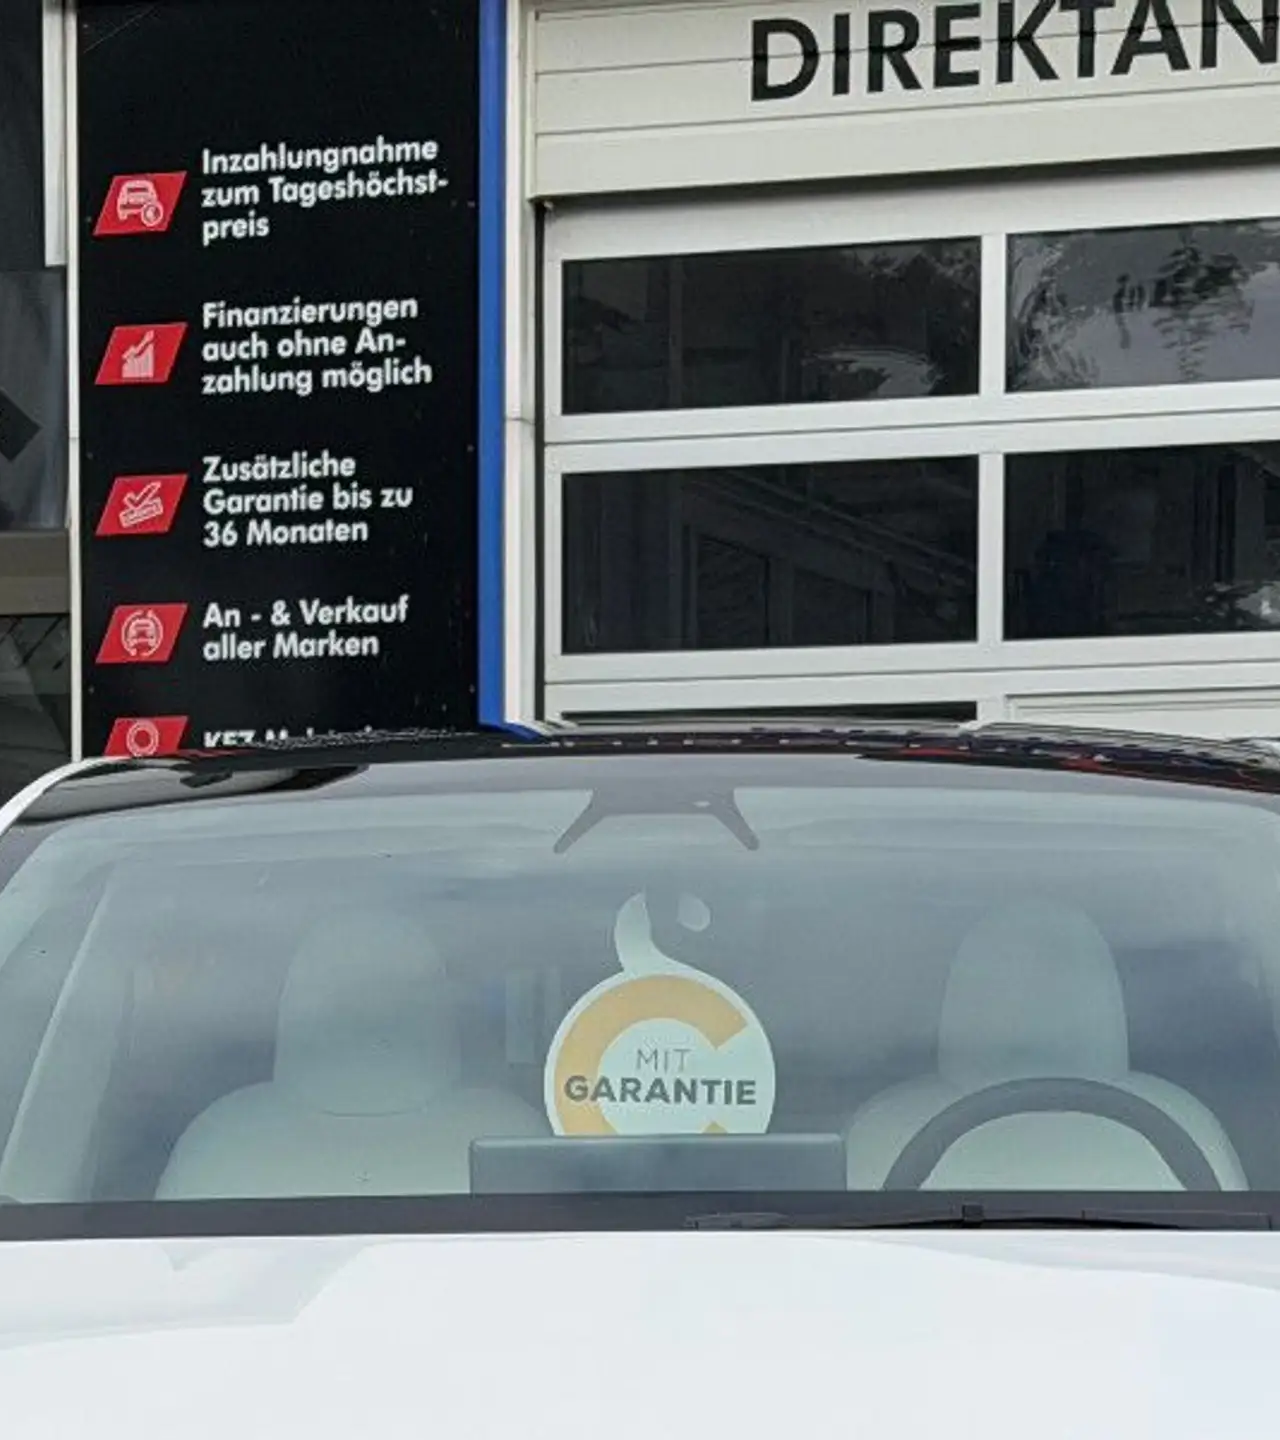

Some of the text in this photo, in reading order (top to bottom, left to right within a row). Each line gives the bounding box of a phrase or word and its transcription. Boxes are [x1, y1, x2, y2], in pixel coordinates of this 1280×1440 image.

[202, 136, 438, 174] Inzahlungnahme
[201, 168, 449, 208] zum Tageshöchst-
[202, 210, 270, 247] preis
[202, 297, 418, 330] Finanzierungen
[202, 326, 407, 362] auch ohne An-
[202, 356, 432, 397] zahlung möglich
[202, 449, 356, 483] Zusätzliche
[203, 481, 413, 515] Garantie bis zu
[203, 518, 368, 548] 36 Monaten
[202, 602, 241, 629] An
[270, 599, 291, 626] &
[299, 594, 409, 625] Verkauf
[203, 629, 379, 661] aller Marken
[636, 1048, 692, 1073] MIT
[564, 1075, 757, 1105] GARANTIE
